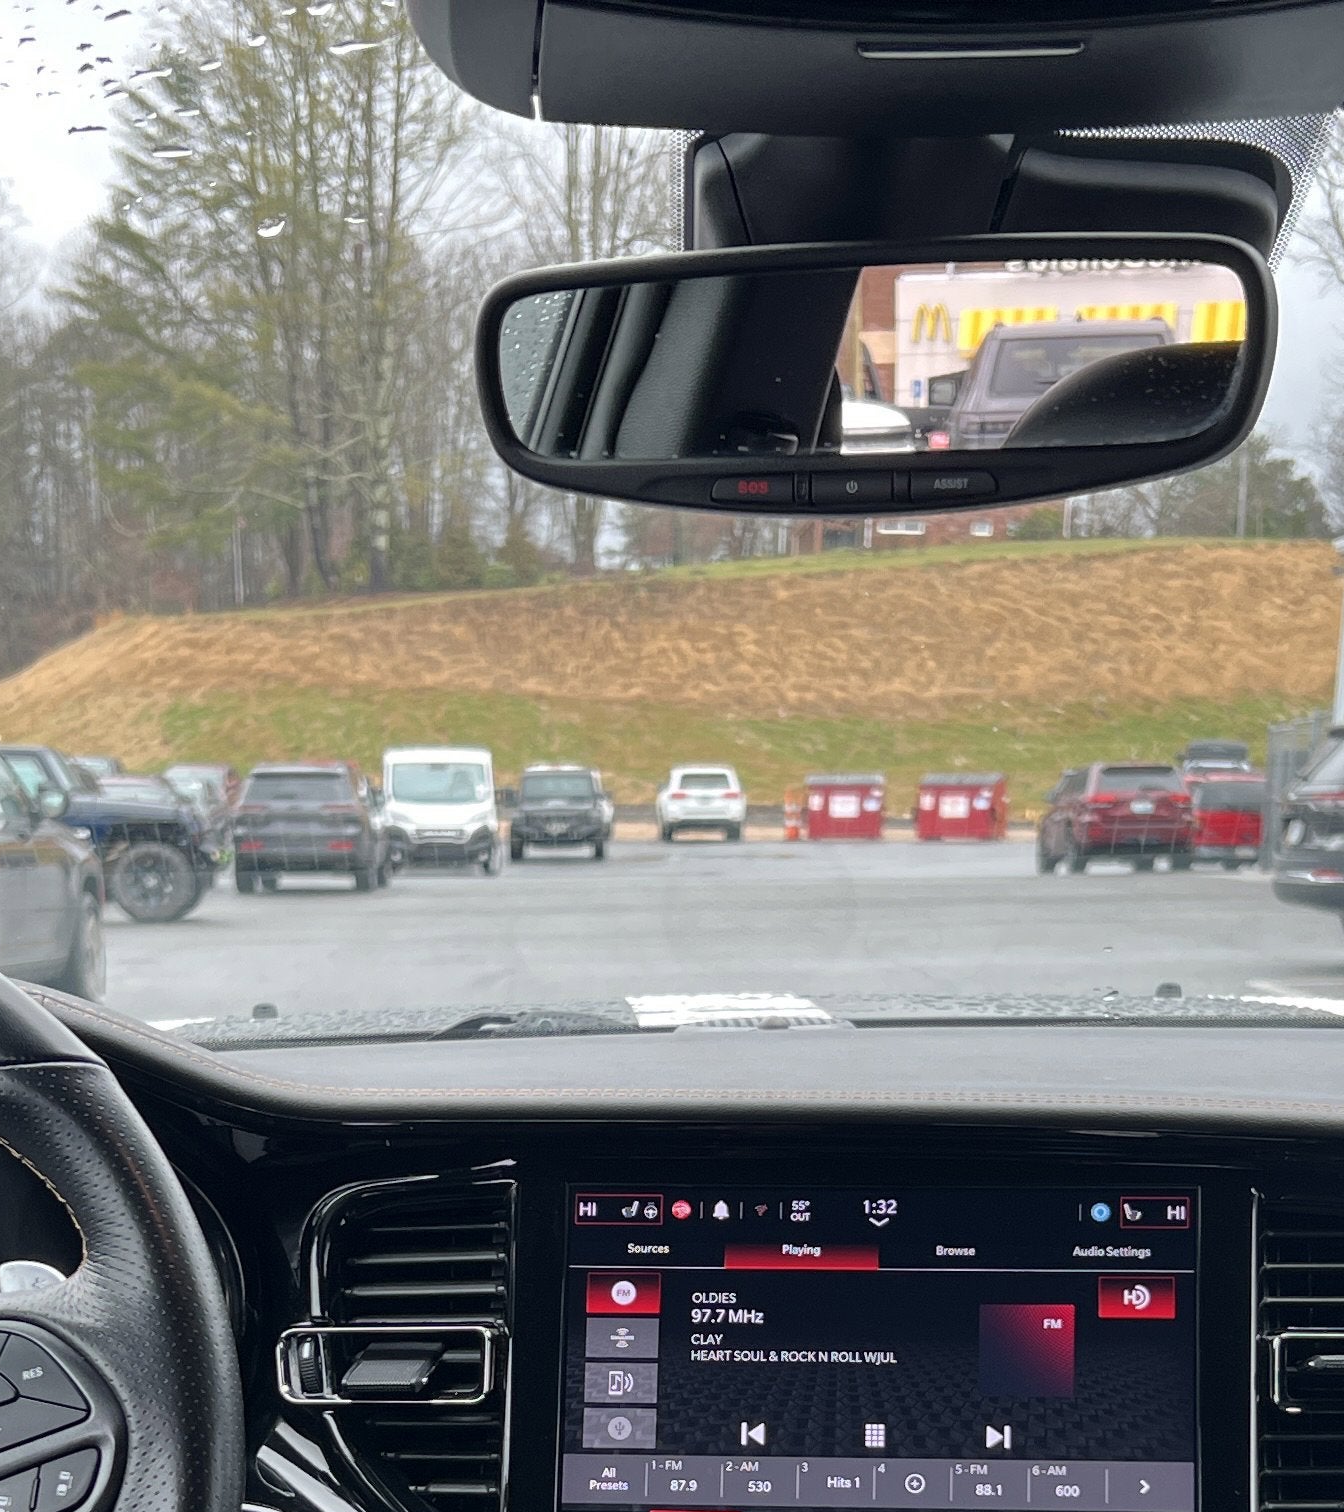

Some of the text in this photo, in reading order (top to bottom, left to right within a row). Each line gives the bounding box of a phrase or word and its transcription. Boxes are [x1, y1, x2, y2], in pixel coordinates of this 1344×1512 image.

[933, 478, 968, 489] ASSIST
[579, 1202, 597, 1216] HI
[863, 1199, 897, 1214] 1:32
[1167, 1205, 1186, 1220] HI
[790, 1212, 810, 1221] OUT
[627, 1243, 670, 1254] Sources
[782, 1244, 821, 1257] Playing
[935, 1245, 976, 1256] Browse
[1072, 1246, 1151, 1259] Audio Settings
[616, 1288, 631, 1297] FM
[691, 1292, 737, 1304] OLDIES
[691, 1309, 764, 1324] 97.7 MHz
[1043, 1318, 1063, 1330] FM
[690, 1334, 723, 1346] CLAY
[690, 1350, 898, 1366] HEART SOUL & ROCK N ROLL WJUL
[22, 1366, 43, 1380] RES
[601, 1467, 616, 1478] All
[801, 1462, 809, 1472] 3
[877, 1463, 886, 1474] 4
[589, 1480, 629, 1491] Presets
[670, 1480, 698, 1492] 87.9
[747, 1481, 772, 1493] 530
[827, 1477, 852, 1489] Hits
[975, 1484, 1003, 1496] 88.1
[1055, 1485, 1080, 1497] 600
